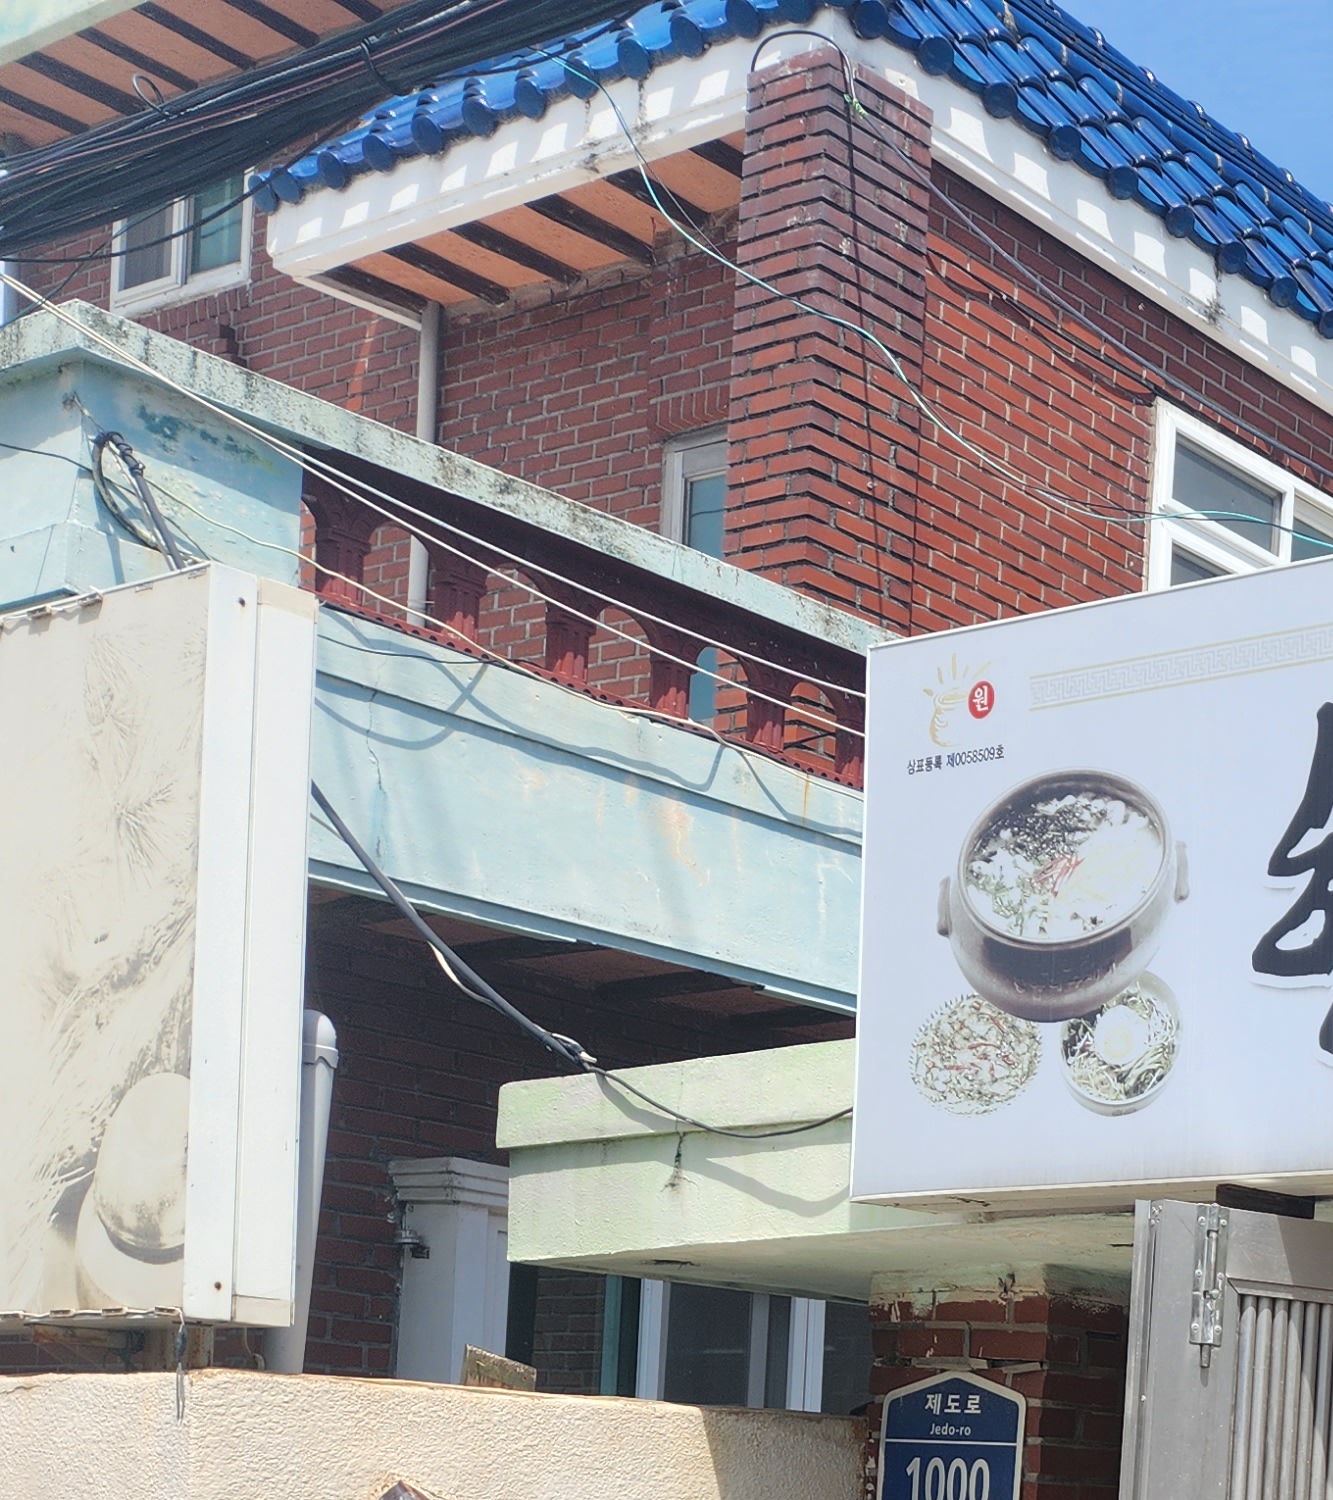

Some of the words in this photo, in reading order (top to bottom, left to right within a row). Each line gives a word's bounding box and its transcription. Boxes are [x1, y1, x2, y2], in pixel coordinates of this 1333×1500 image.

[972, 685, 989, 711] 원
[907, 755, 943, 775] 상표등록
[946, 744, 1005, 768] 제0058509호
[925, 1393, 981, 1415] 제도로
[930, 1422, 972, 1436] Jedo-ro
